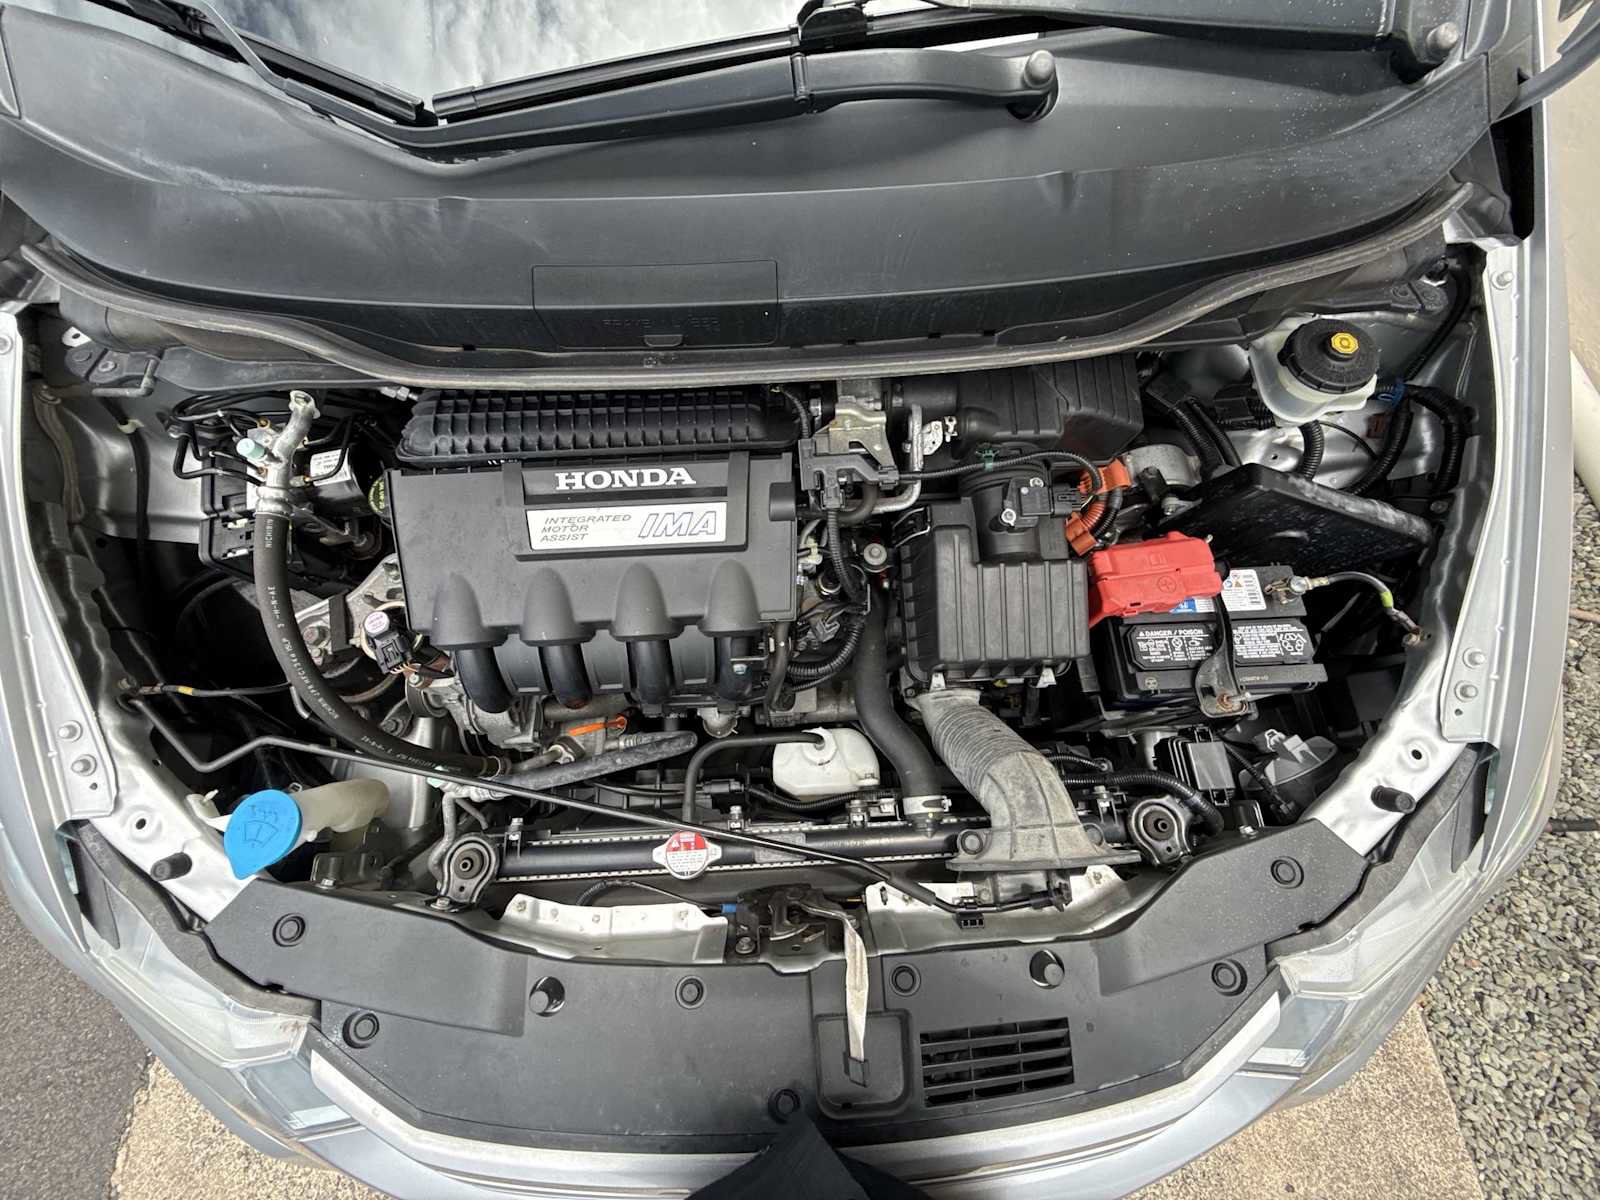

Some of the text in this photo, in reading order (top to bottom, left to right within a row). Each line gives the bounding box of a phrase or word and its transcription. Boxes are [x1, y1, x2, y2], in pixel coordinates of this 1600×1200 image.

[555, 467, 696, 491] HONDA
[544, 514, 632, 525] INTEGRATED
[638, 510, 717, 538] IMA
[541, 524, 589, 533] MOTOR
[540, 533, 588, 542] ASSIST
[1145, 629, 1173, 637] DANGER
